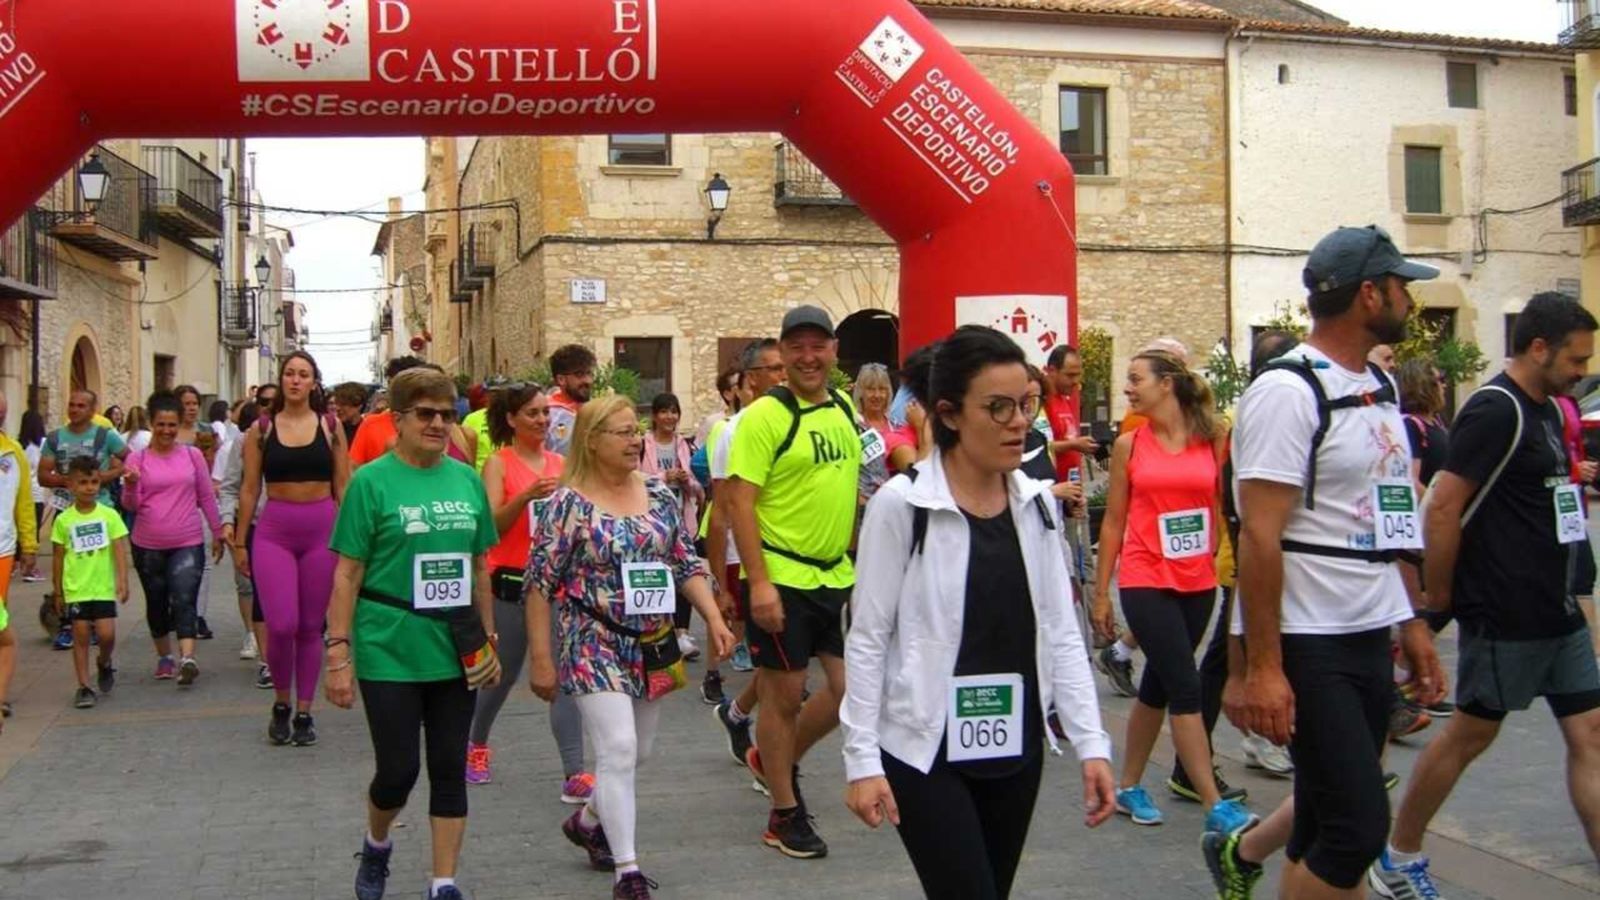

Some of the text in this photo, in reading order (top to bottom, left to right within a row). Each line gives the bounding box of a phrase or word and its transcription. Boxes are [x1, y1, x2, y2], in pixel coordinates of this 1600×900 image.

[378, 0, 641, 34] D E
[376, 38, 642, 83] CASTELLÓ
[241, 92, 656, 119] #CSEscenarioDeportivo
[925, 67, 1020, 164] CASTELLÓN,
[910, 84, 1007, 177] ESCENARIO
[891, 101, 990, 196] DEPORTIVO
[80, 535, 103, 548] 103
[1383, 514, 1415, 540] 045
[1170, 533, 1201, 553] 051
[424, 580, 461, 601] 093
[633, 589, 666, 608] 077
[960, 718, 1008, 749] 066
